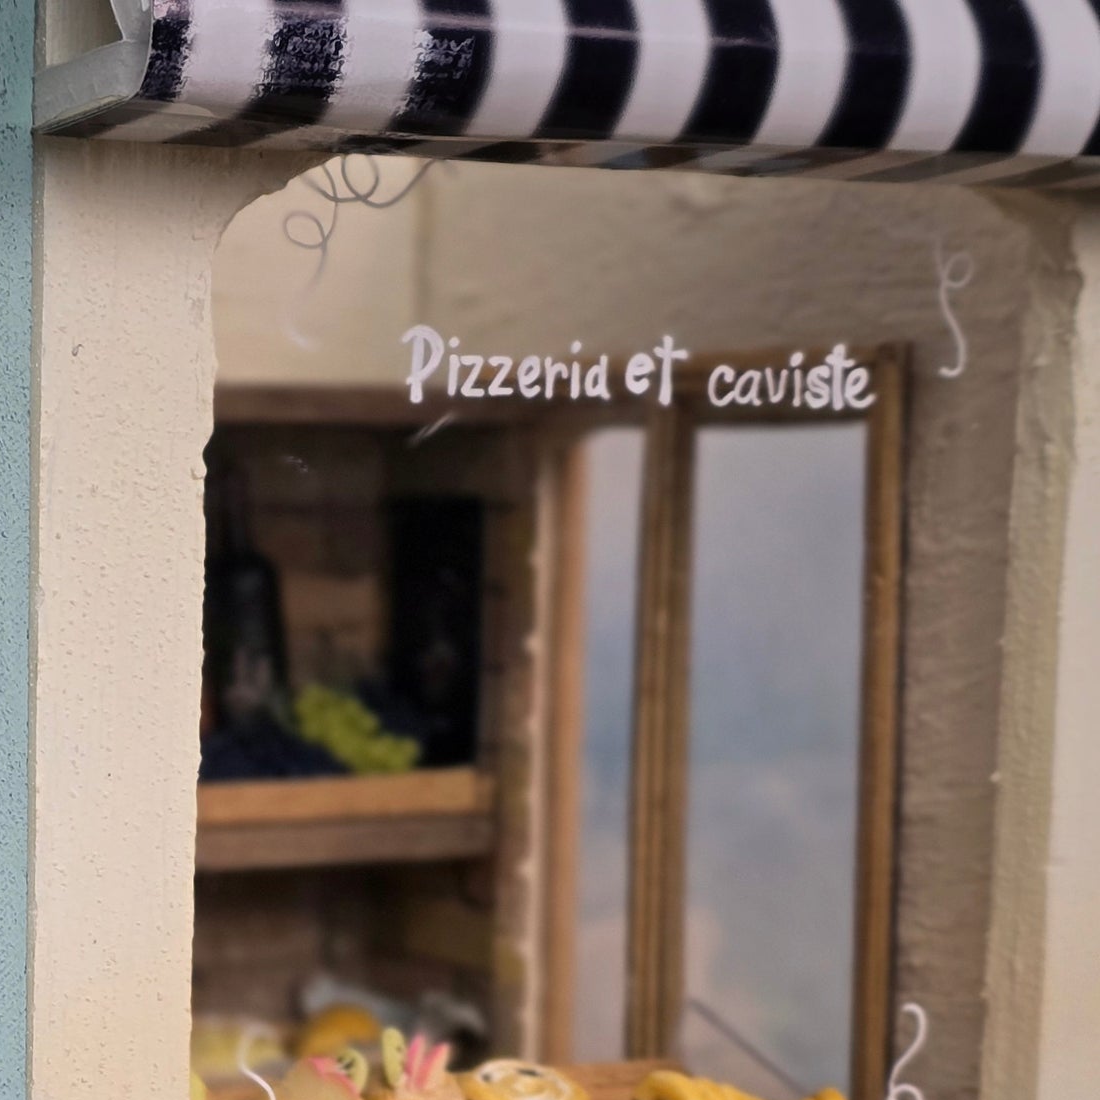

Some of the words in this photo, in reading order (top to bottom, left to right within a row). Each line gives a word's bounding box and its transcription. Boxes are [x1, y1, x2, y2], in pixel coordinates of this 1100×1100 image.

[402, 325, 610, 403] Pizzeria
[624, 335, 689, 405] et
[707, 343, 876, 411] caviste
